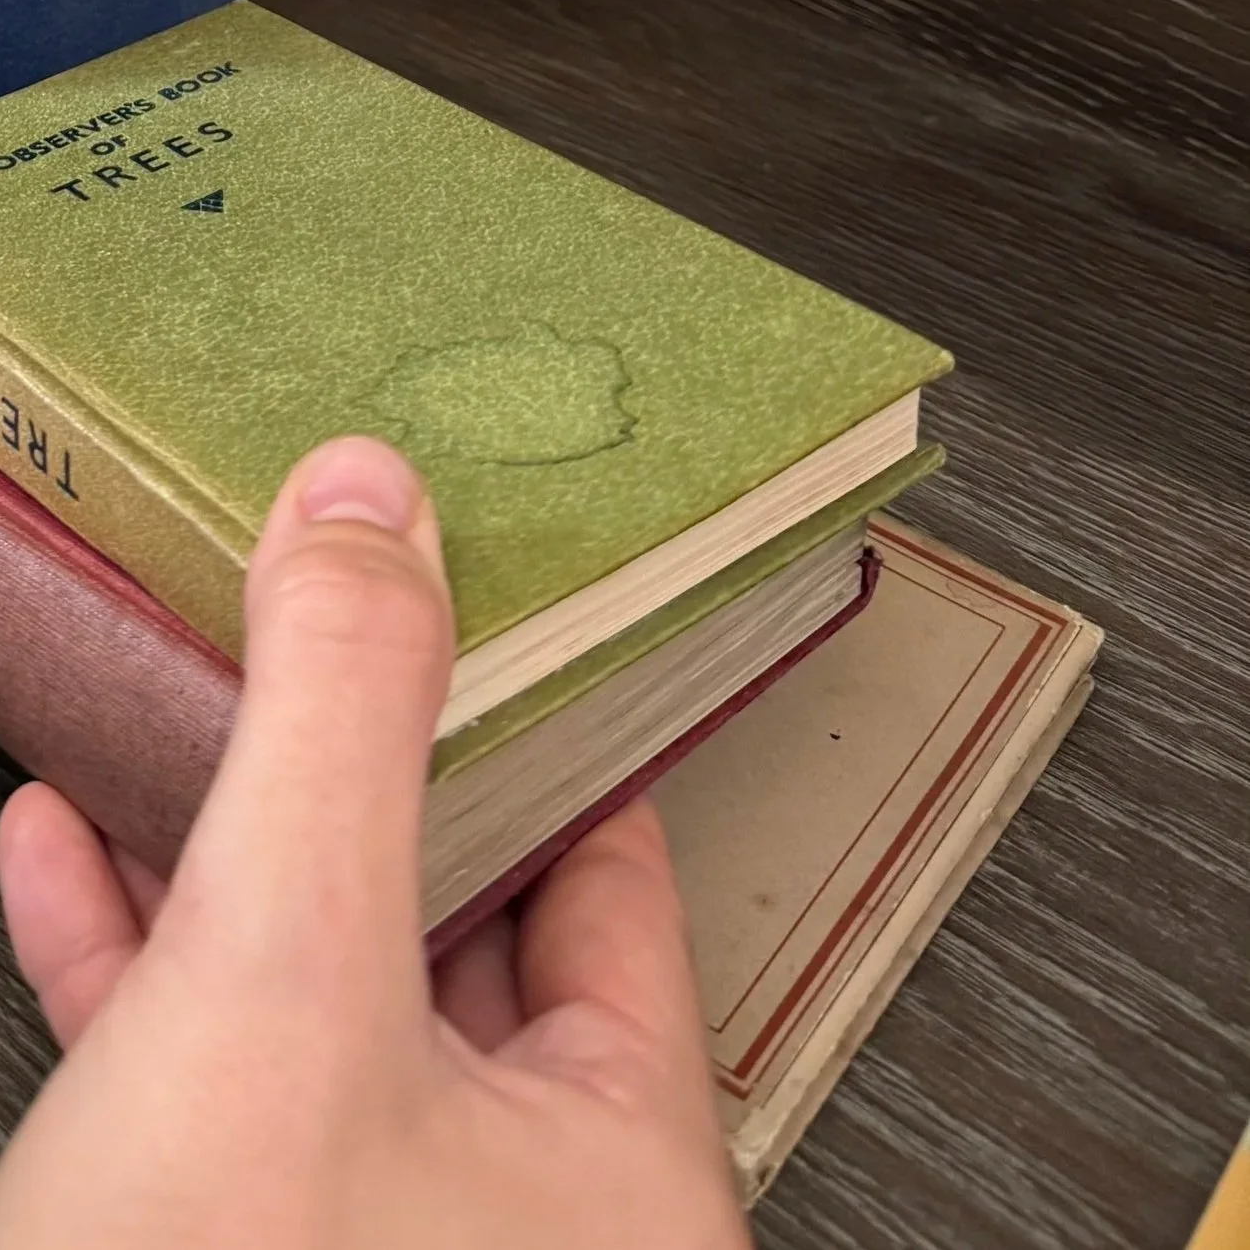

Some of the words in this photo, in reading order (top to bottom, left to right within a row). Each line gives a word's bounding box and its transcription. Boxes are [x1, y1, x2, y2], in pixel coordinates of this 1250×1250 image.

[157, 60, 243, 102] BOOK
[50, 121, 235, 202] TREES
[90, 134, 131, 157] OF
